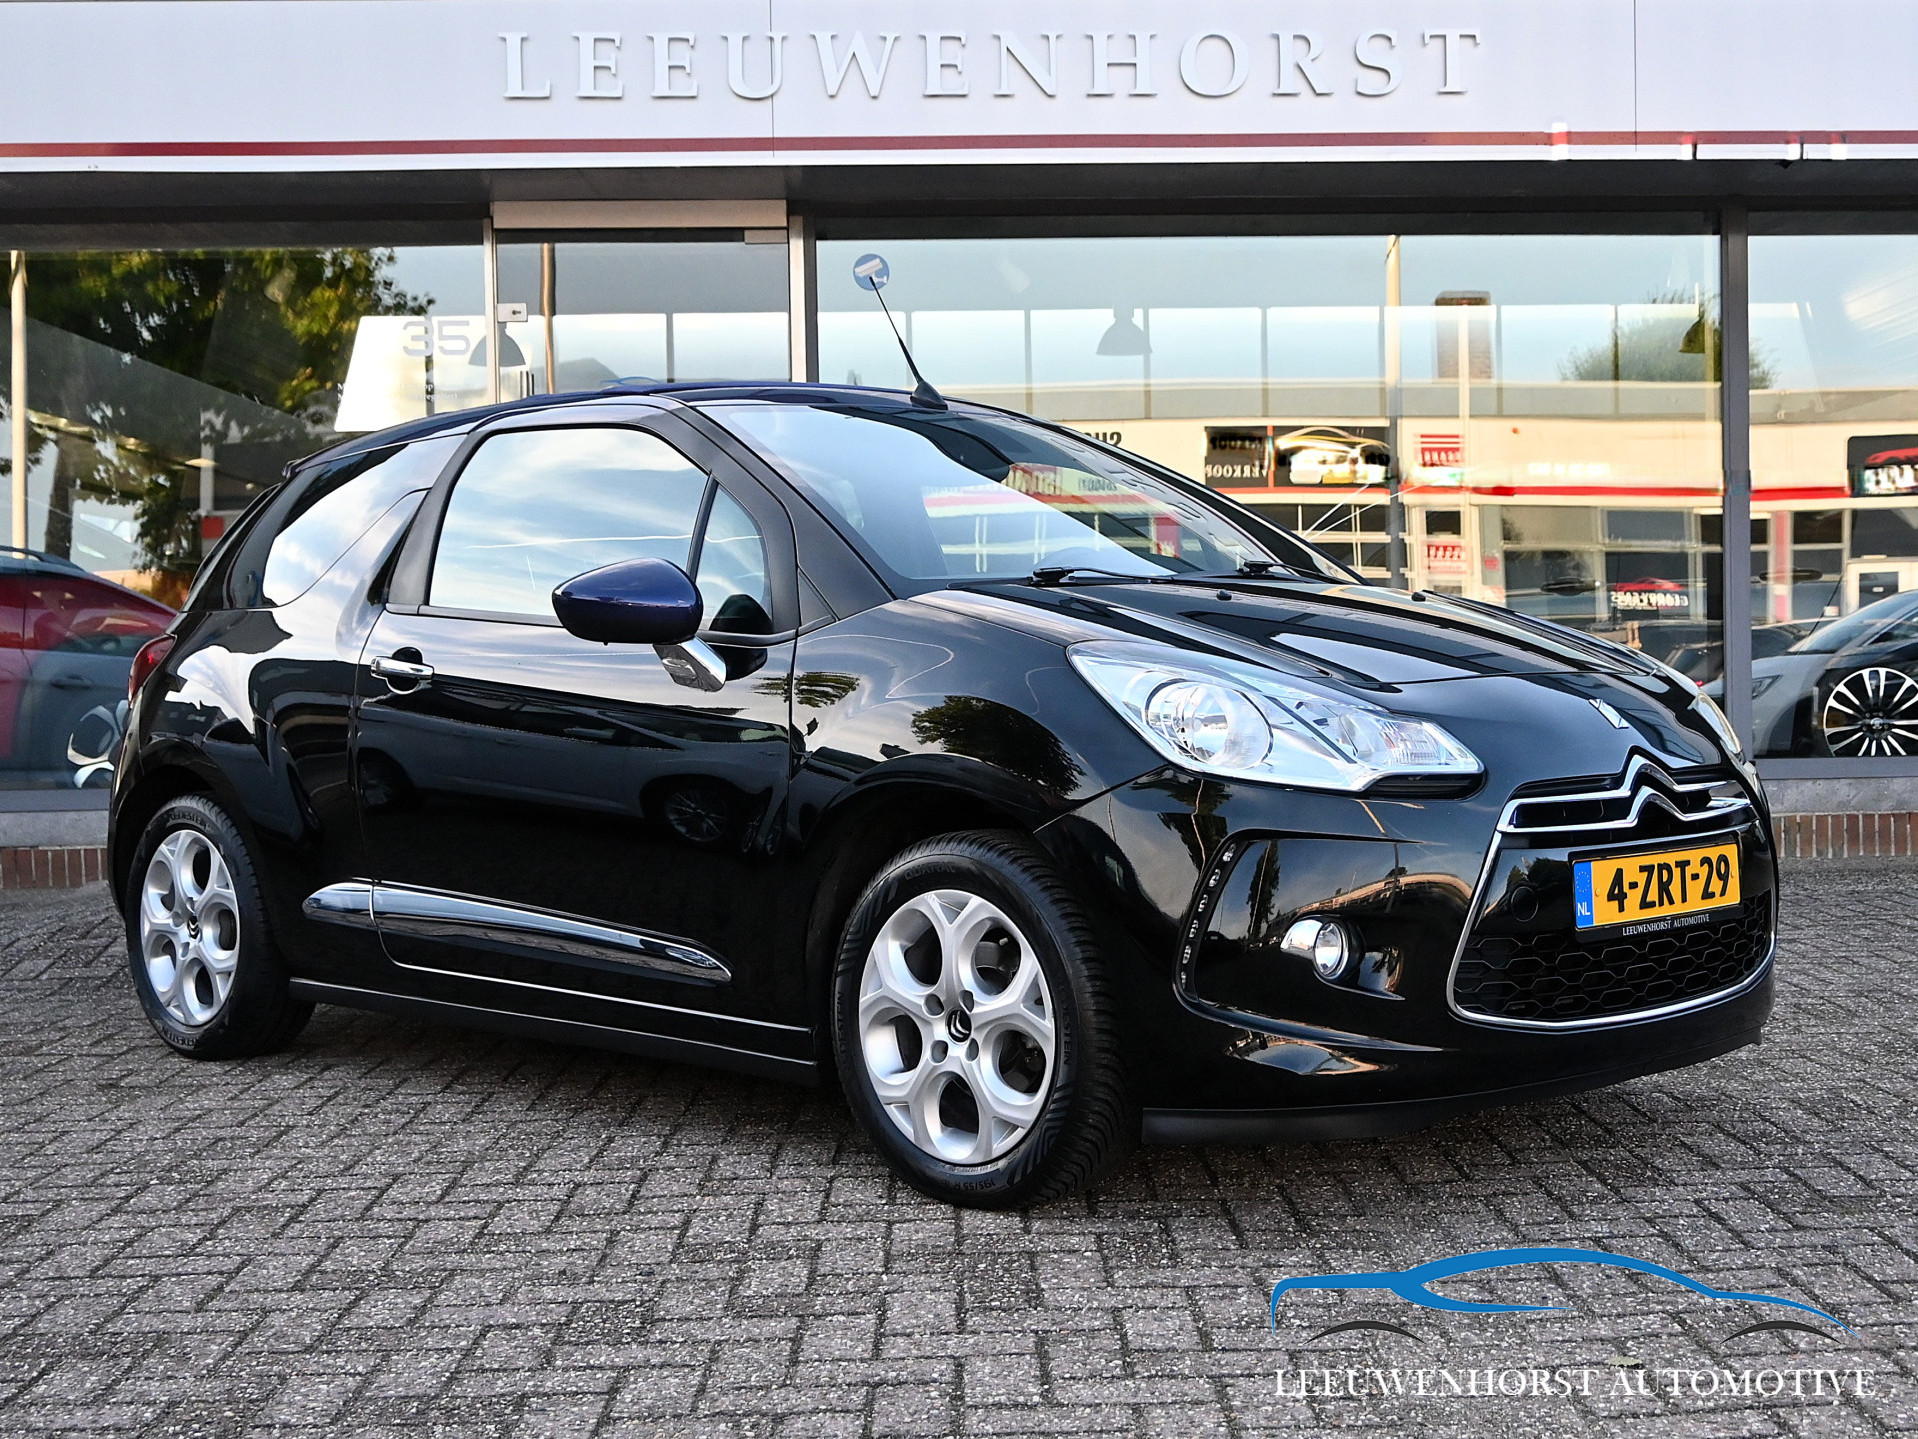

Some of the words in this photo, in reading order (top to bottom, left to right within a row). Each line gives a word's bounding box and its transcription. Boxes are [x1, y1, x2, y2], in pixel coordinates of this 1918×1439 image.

[498, 29, 1482, 101] LEEUWENHORST
[402, 320, 471, 357] 35
[1606, 853, 1731, 913] 4-ZRT-29
[1577, 901, 1591, 917] NL
[1622, 920, 1672, 936] LEEUWENHORST
[1673, 914, 1710, 928] AUTOMOTIVE
